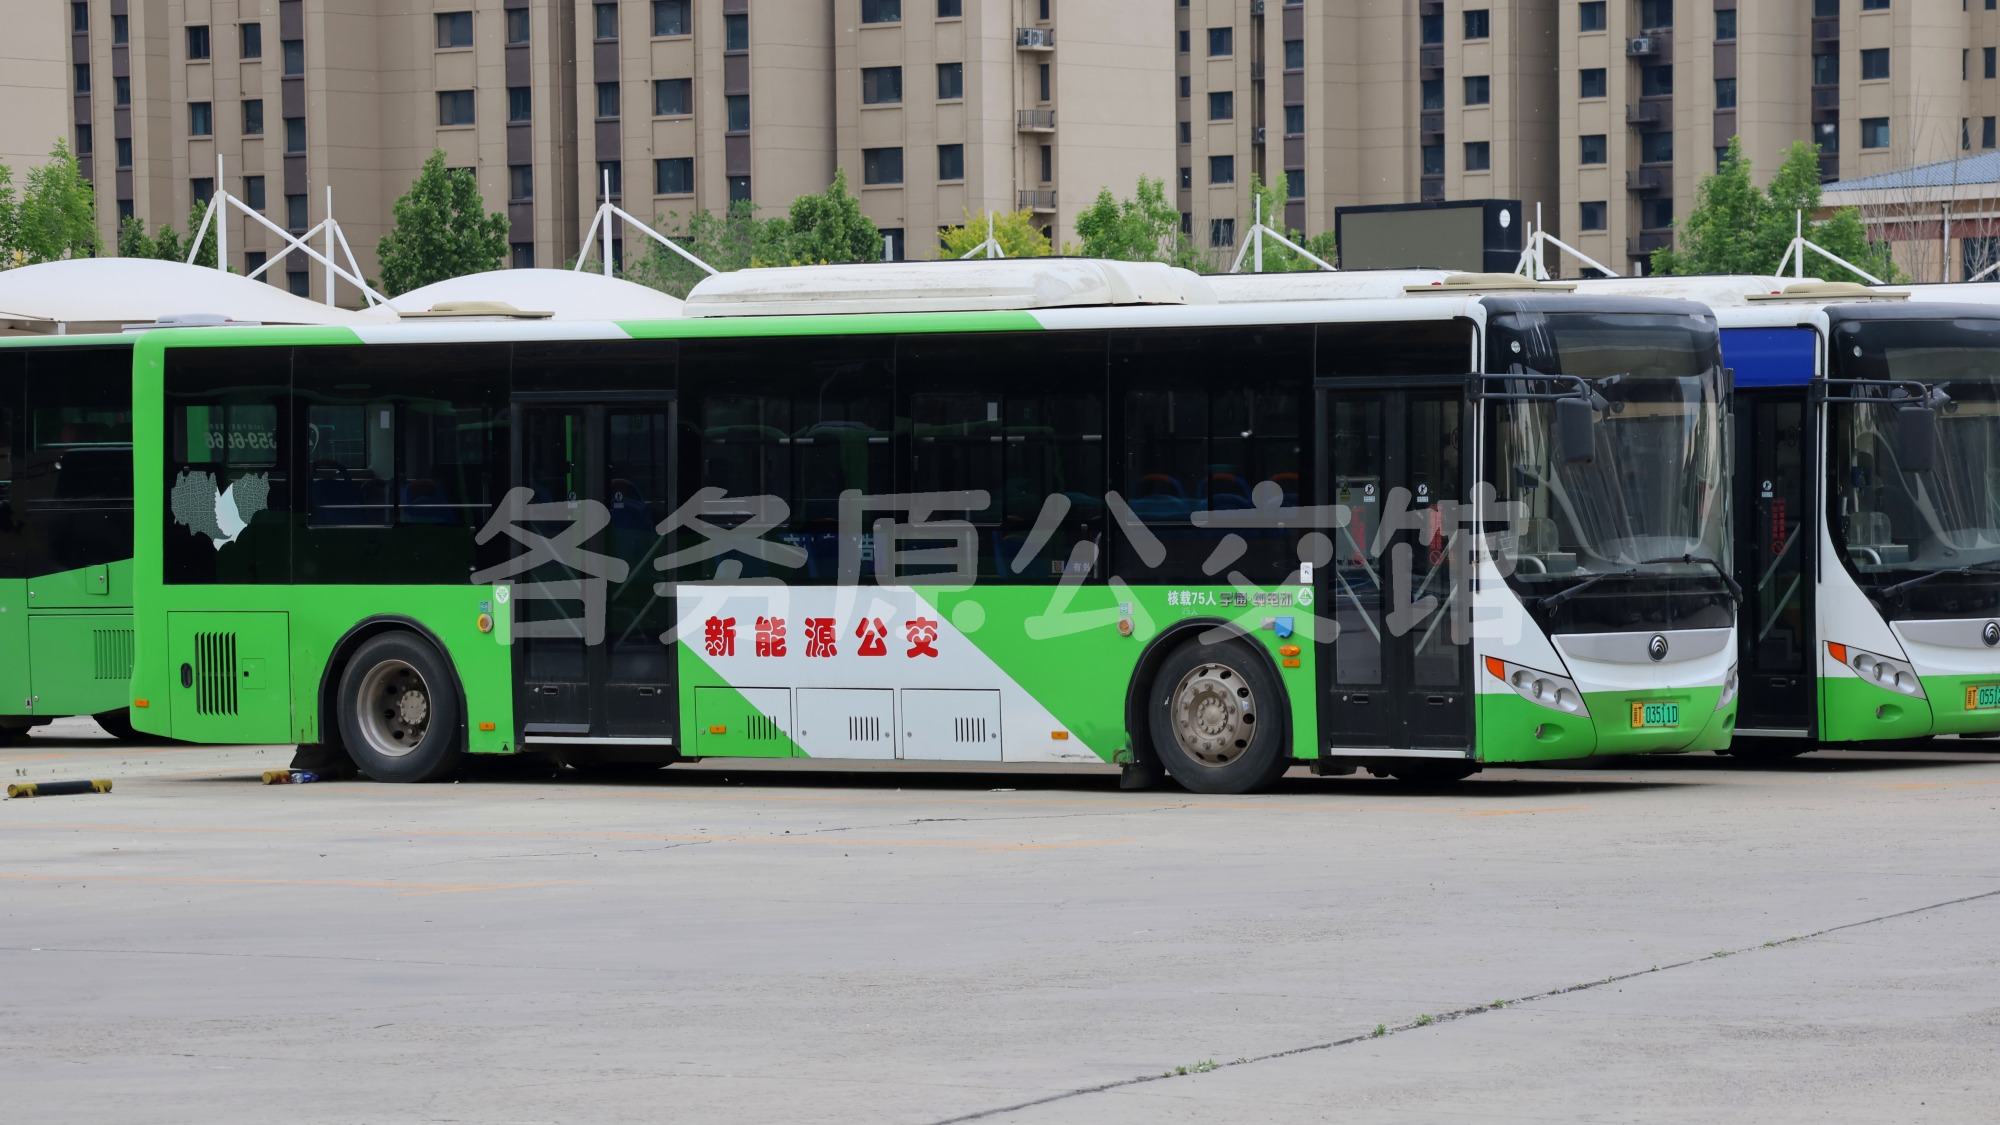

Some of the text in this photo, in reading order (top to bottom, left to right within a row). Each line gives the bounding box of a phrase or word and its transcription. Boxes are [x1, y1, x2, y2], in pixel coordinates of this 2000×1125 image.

[1167, 590, 1217, 606] 核载75人
[705, 616, 939, 658] 新能源公交
